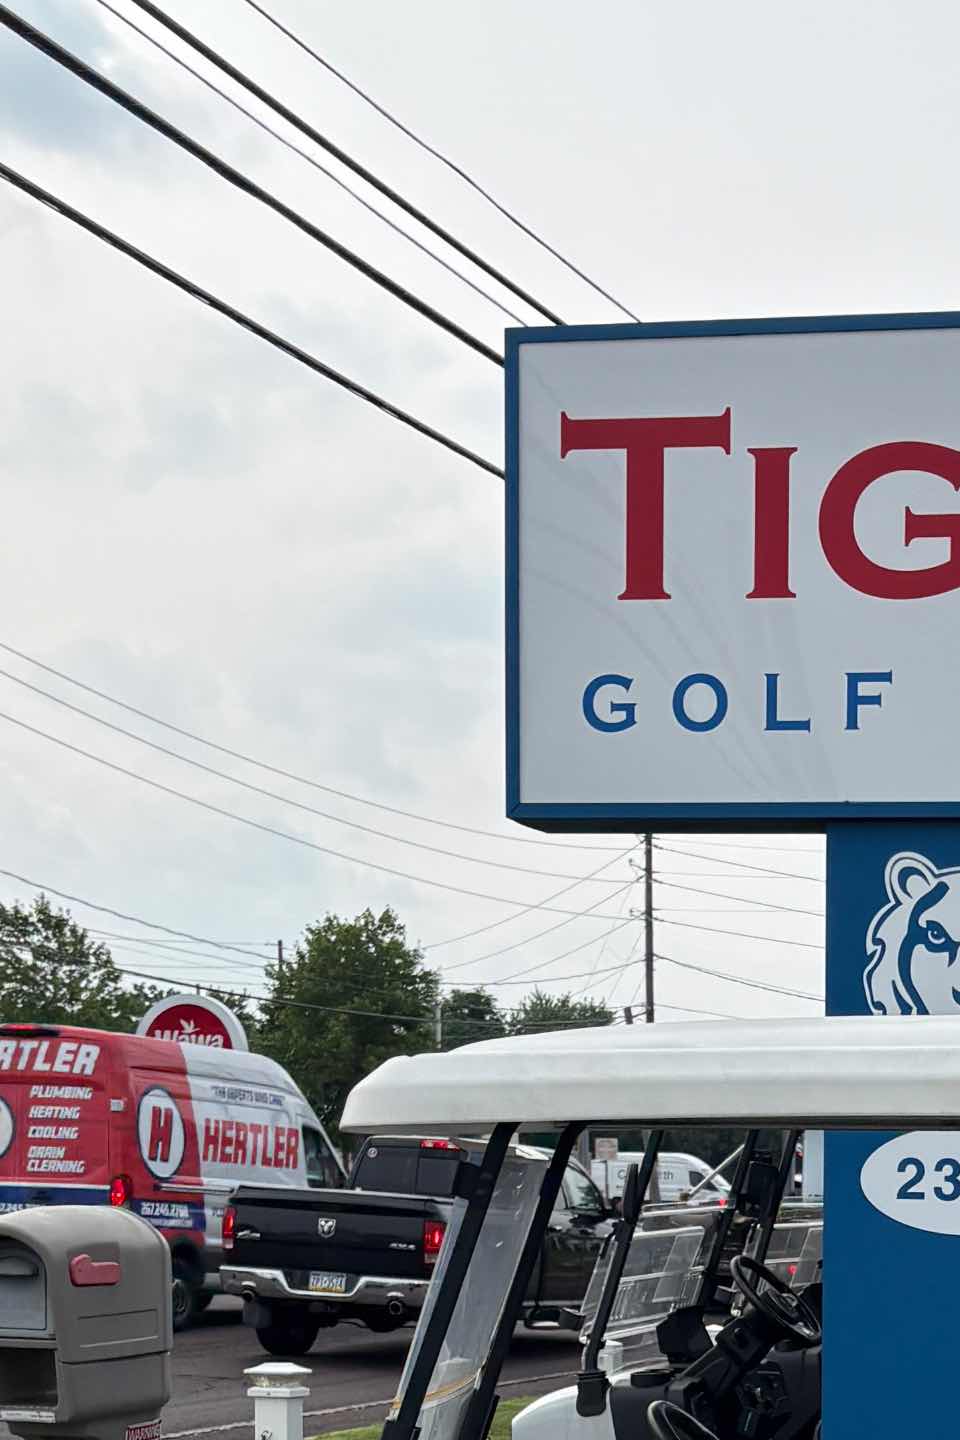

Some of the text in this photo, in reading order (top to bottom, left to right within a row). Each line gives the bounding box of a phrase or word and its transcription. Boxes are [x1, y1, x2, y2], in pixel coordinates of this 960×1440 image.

[581, 670, 893, 734] GOLF
[29, 1084, 93, 1099] PLUMBING
[28, 1105, 81, 1119] HEATING
[27, 1126, 79, 1139] COOLING
[148, 1105, 173, 1162] H
[202, 1117, 299, 1169] HERTLER
[26, 1159, 86, 1173] CLEANING
